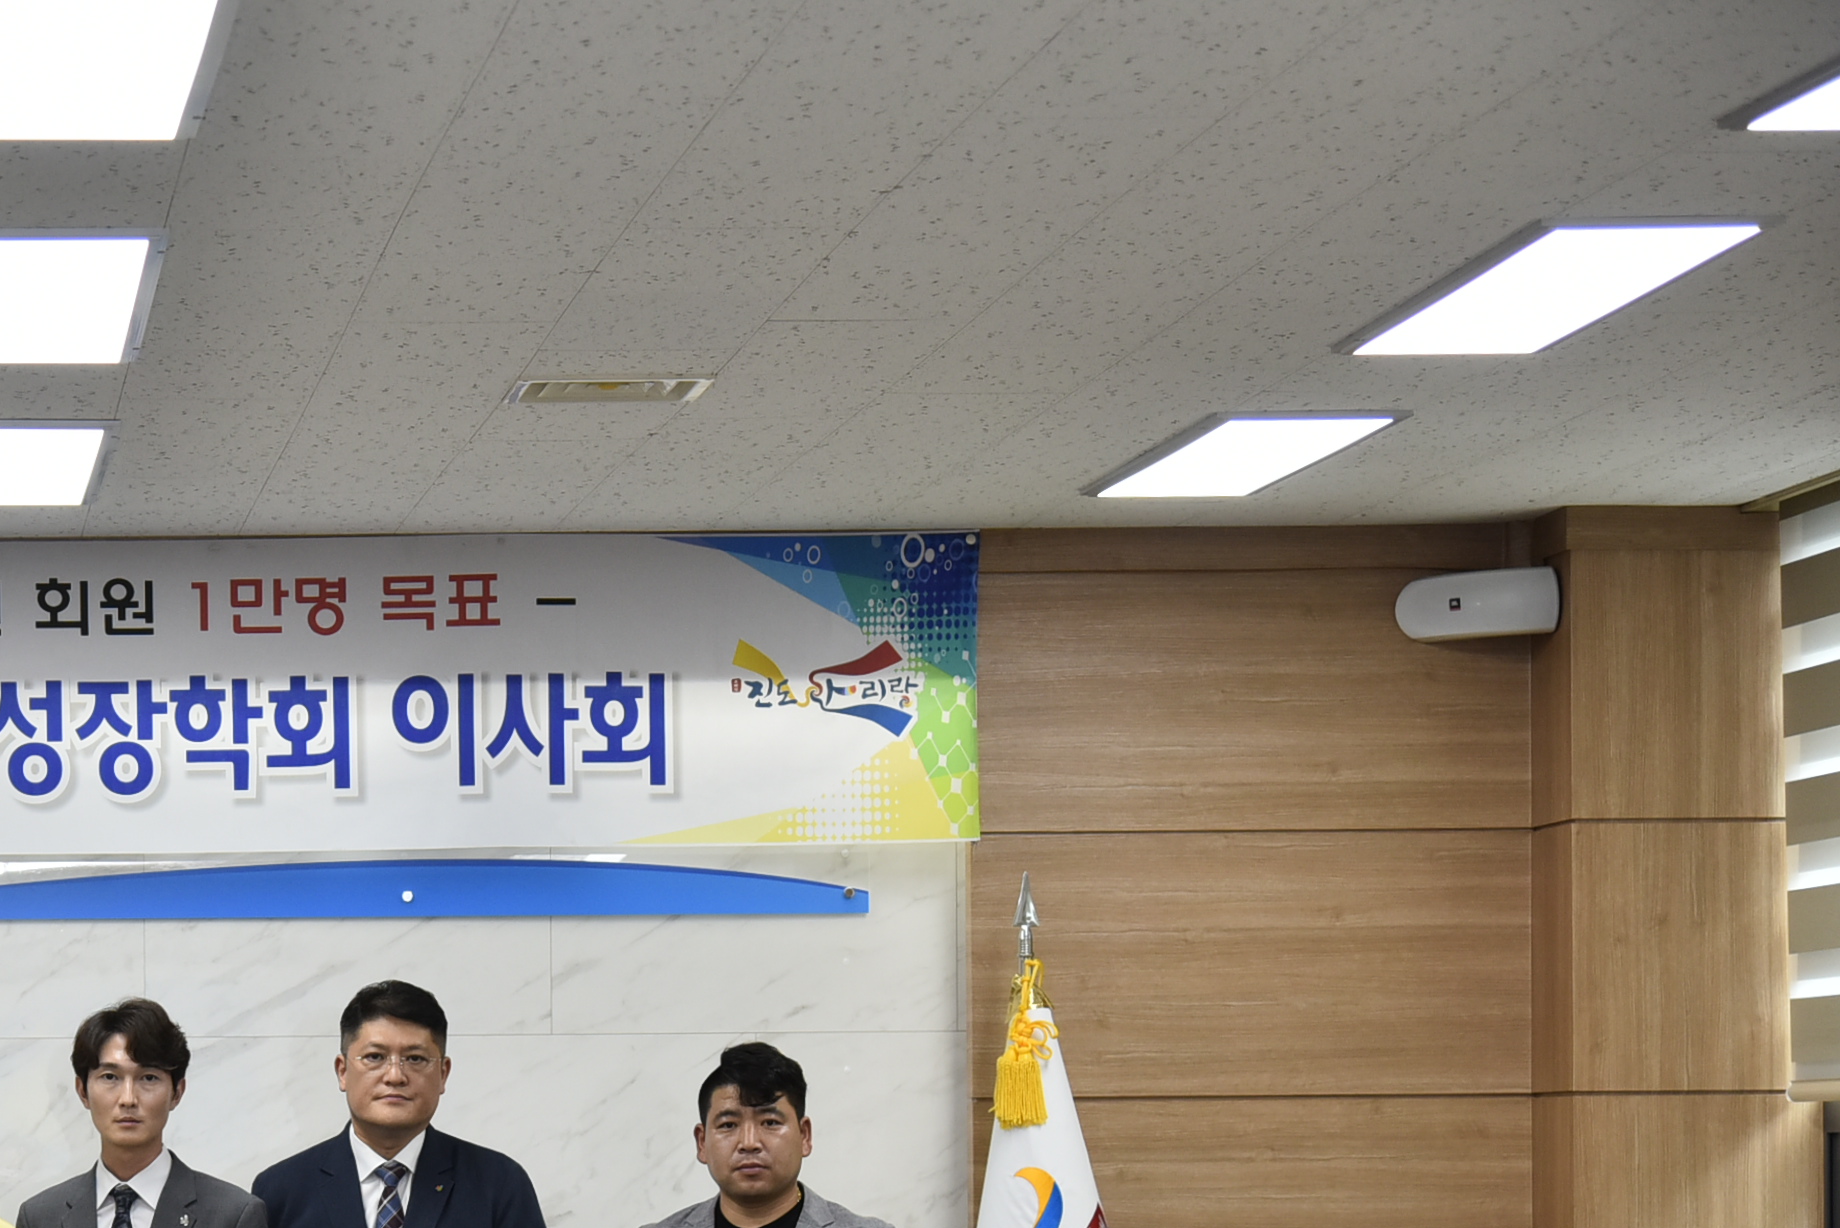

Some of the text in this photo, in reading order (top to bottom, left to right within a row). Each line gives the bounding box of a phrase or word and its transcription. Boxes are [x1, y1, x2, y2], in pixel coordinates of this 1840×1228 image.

[35, 577, 155, 637] 회원
[191, 577, 347, 636] 1만명
[381, 573, 501, 631] 목표
[393, 679, 667, 788] 이사회
